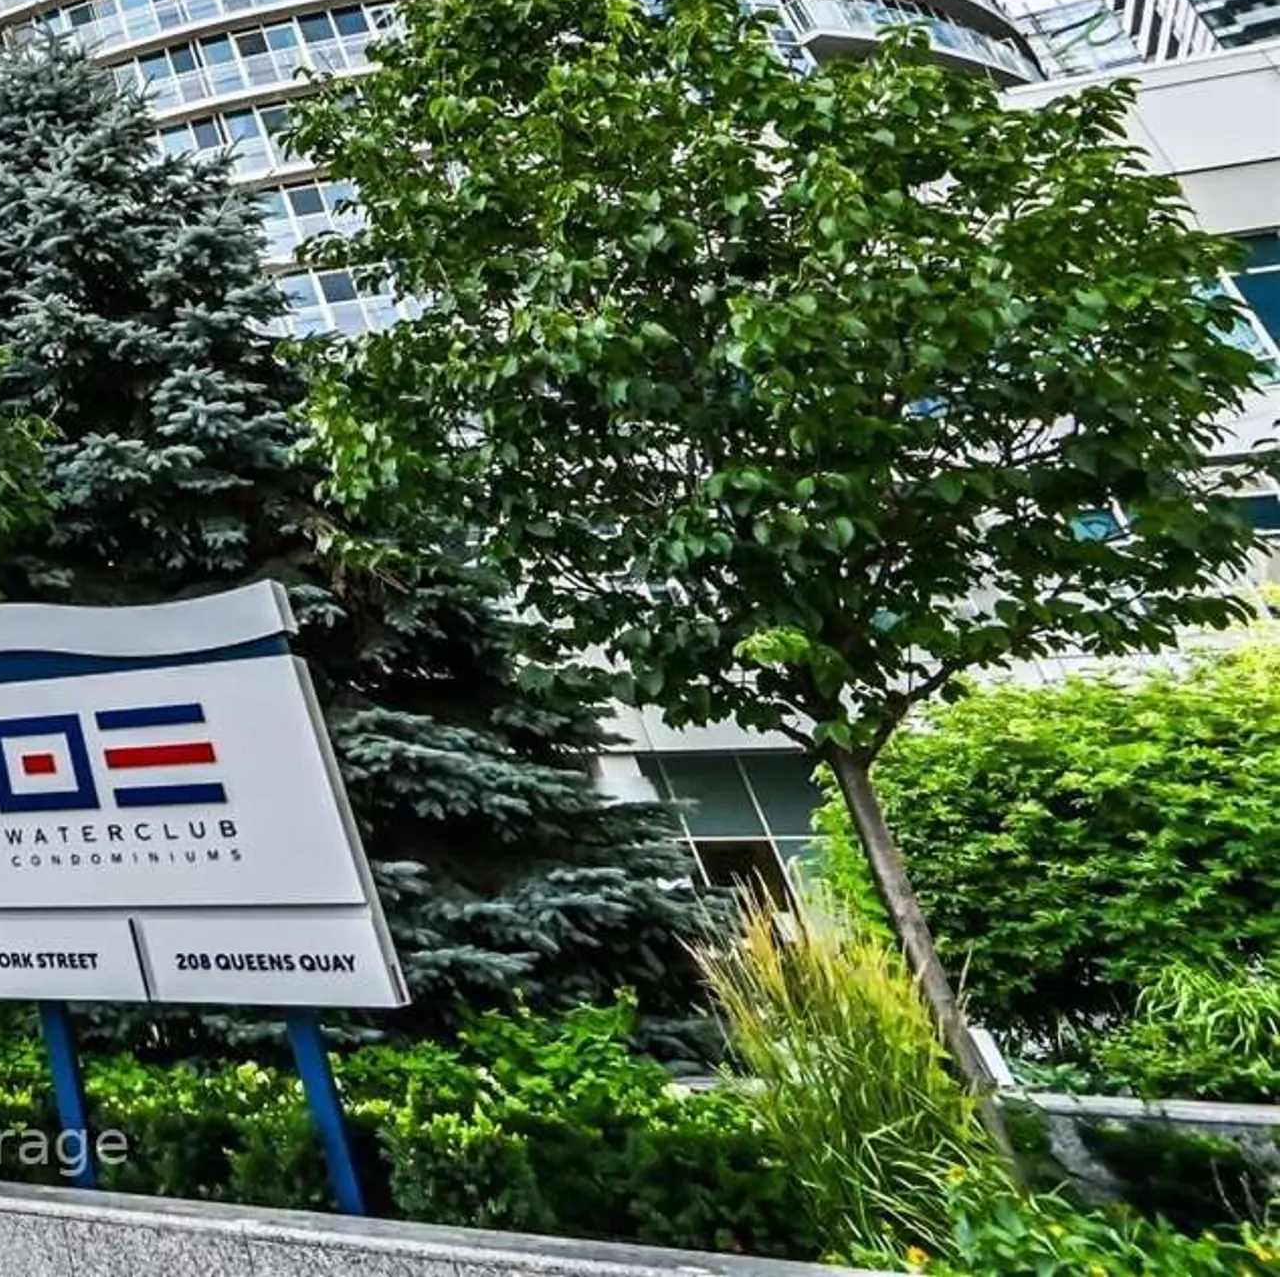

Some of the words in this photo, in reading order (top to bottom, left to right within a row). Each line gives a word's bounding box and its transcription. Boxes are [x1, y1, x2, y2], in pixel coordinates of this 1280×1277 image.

[4, 820, 238, 846] WATERCLUB
[11, 848, 243, 868] CONDOMINIUMS
[38, 952, 99, 970] STREET
[176, 952, 212, 971] 208
[215, 953, 297, 973] QUEENS
[298, 953, 357, 973] QUAY
